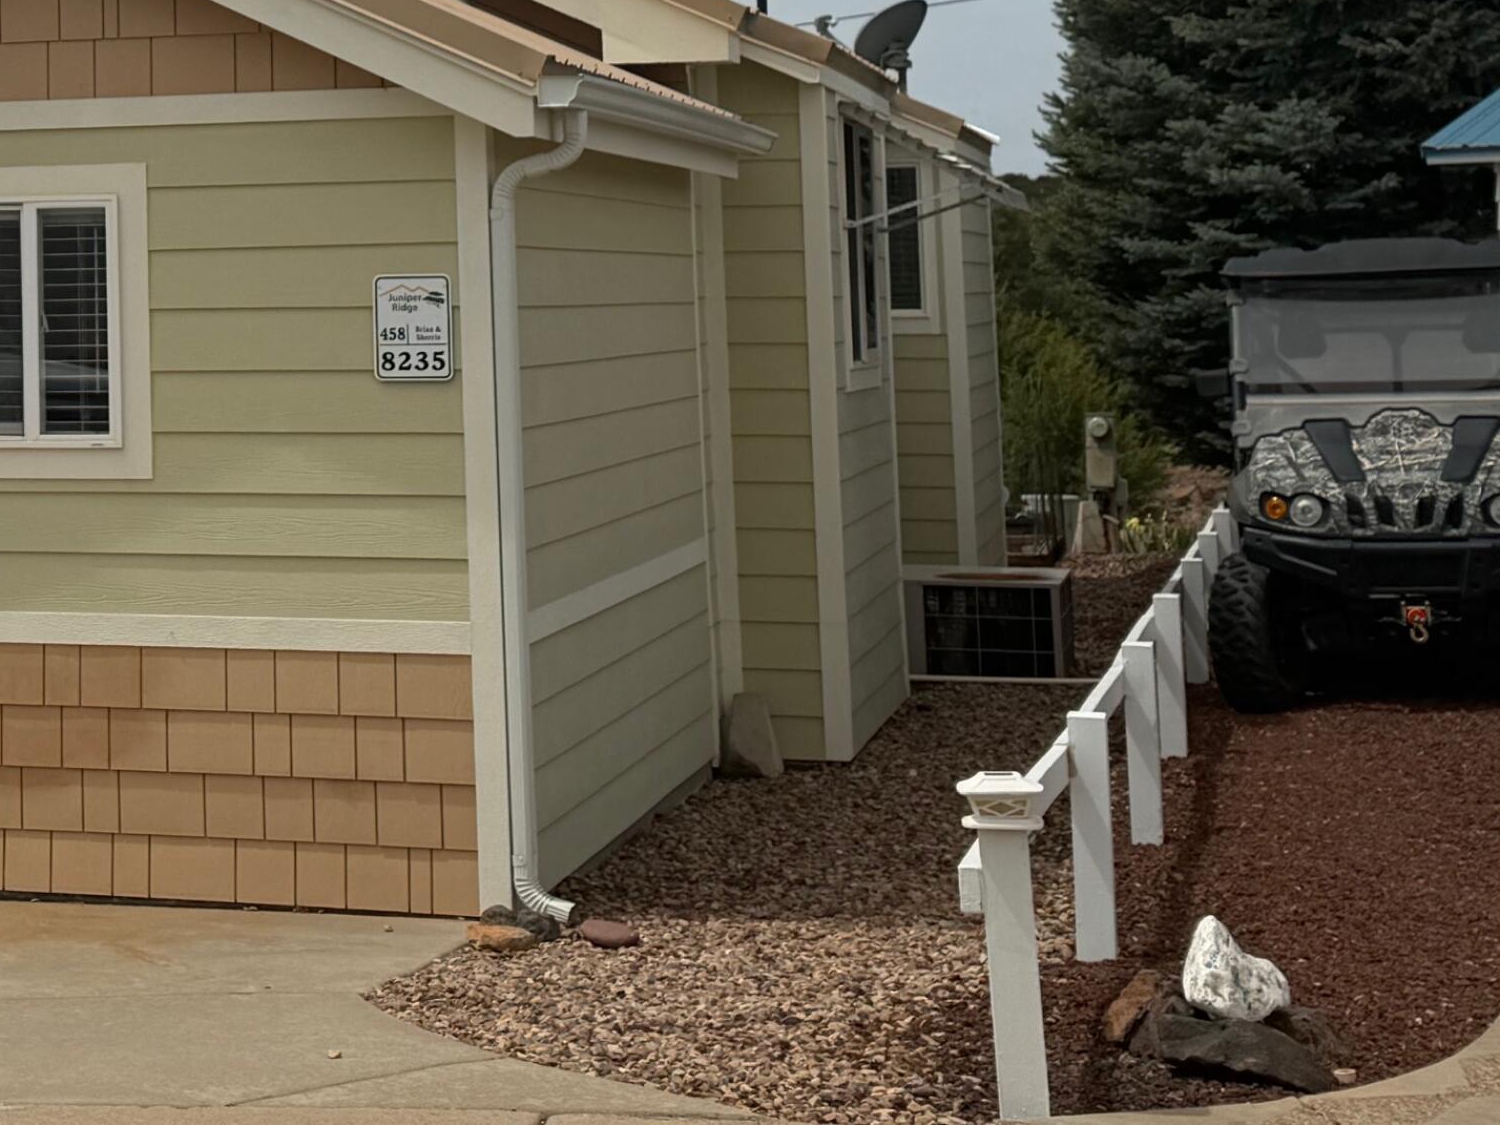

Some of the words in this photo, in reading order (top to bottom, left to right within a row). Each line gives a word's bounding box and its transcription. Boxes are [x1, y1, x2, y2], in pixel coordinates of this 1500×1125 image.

[388, 293, 422, 303] Juniper
[392, 303, 419, 313] Ridge
[380, 326, 406, 341] 458
[381, 350, 446, 371] 8235
